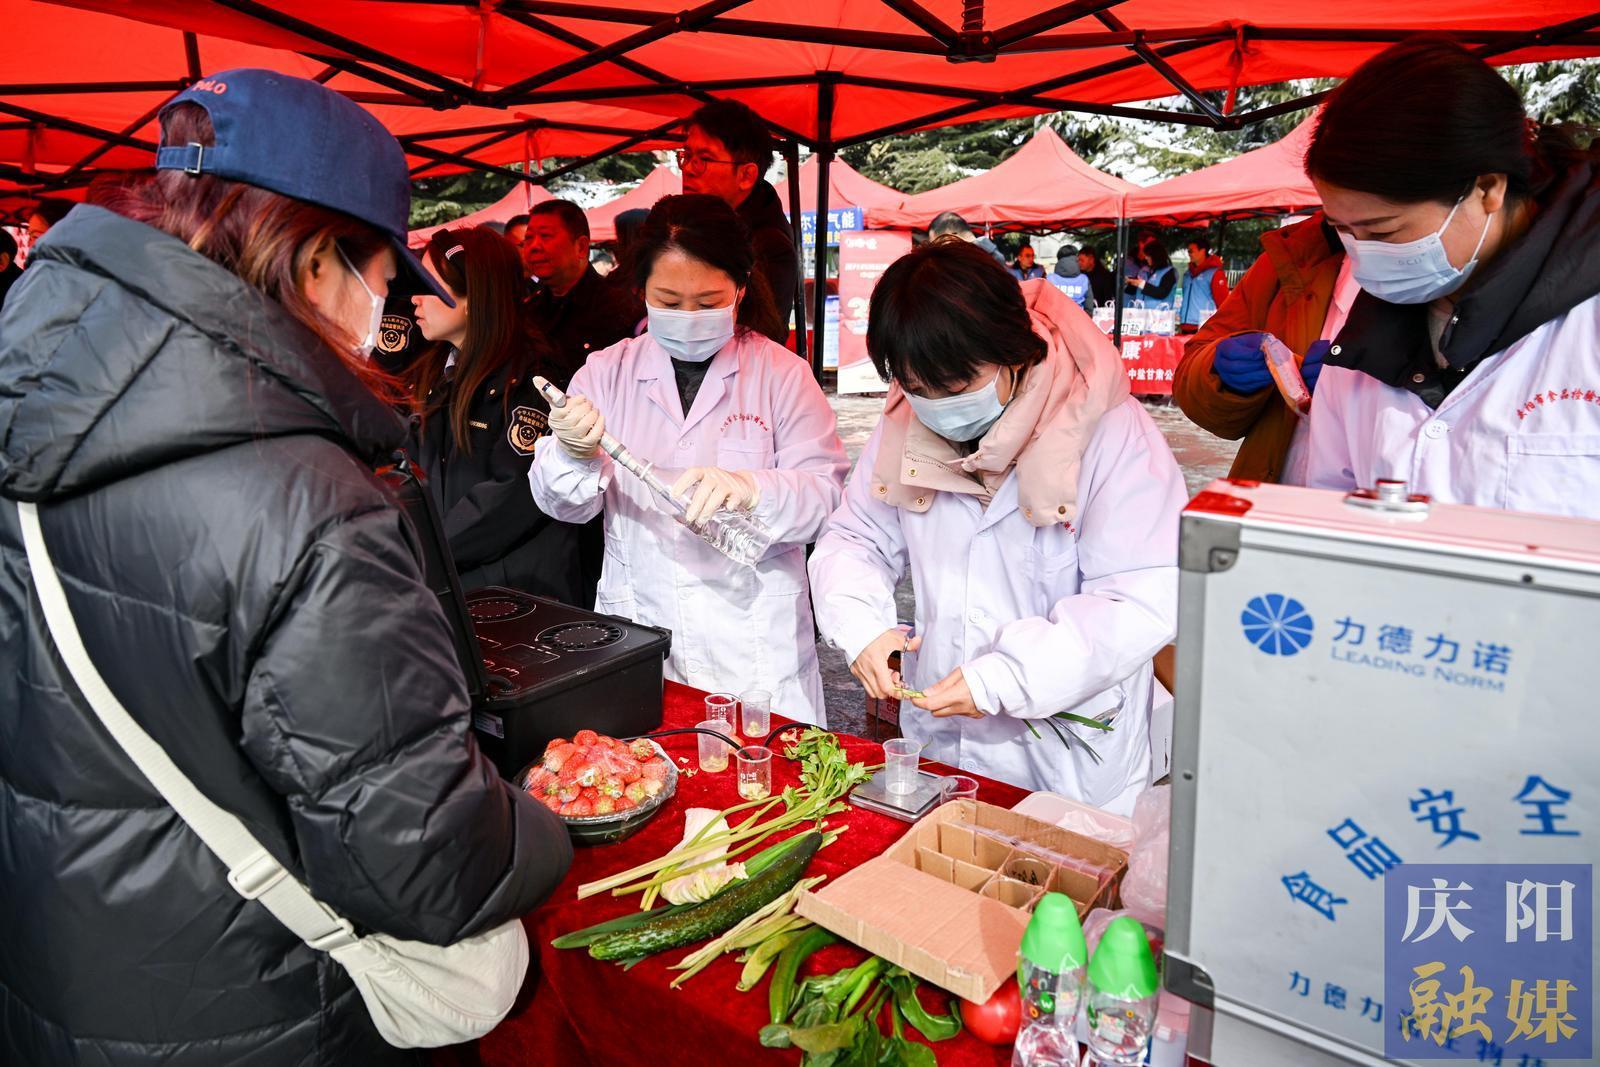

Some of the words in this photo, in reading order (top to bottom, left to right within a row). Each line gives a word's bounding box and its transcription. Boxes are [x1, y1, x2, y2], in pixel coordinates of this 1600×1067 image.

[192, 79, 227, 95] POLO
[1330, 645, 1426, 678] LEADING
[1433, 665, 1505, 694] NORM
[1333, 616, 1513, 676] 力德力诺
[1281, 774, 1581, 922] 食品安全
